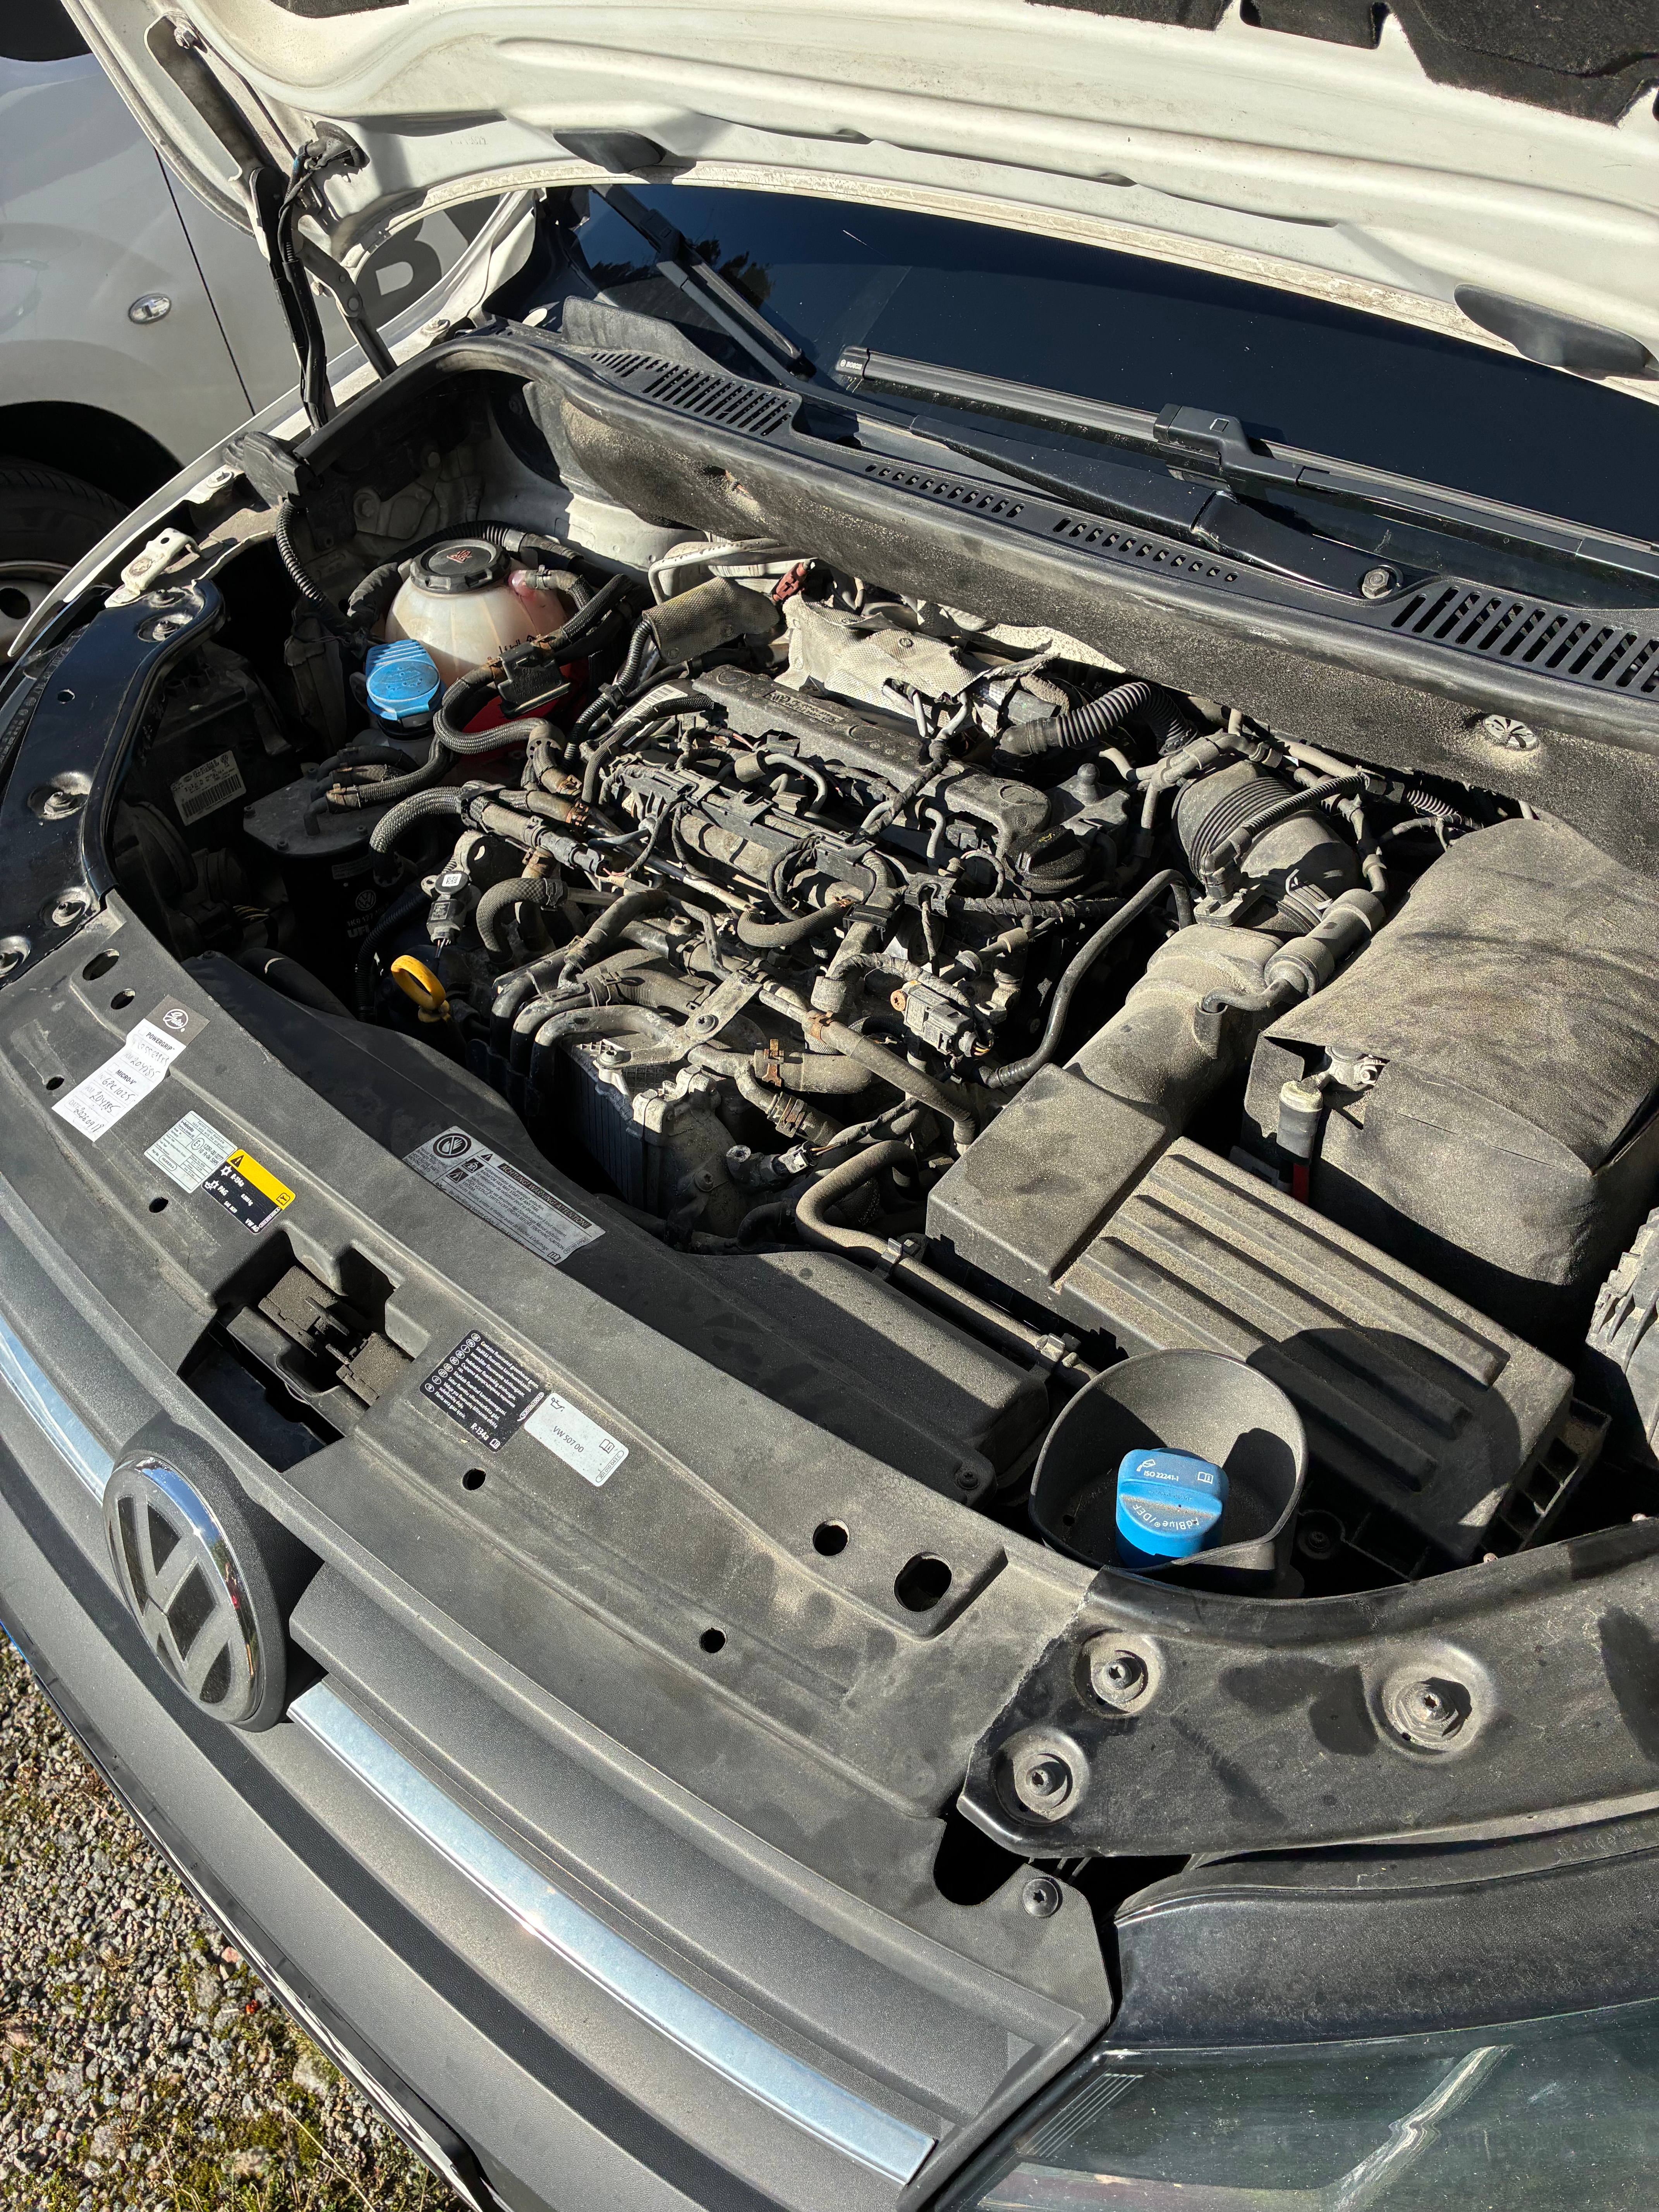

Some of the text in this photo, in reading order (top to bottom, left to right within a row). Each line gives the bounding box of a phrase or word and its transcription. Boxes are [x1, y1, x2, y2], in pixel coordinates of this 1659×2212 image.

[216, 1185, 229, 1196] PAG
[500, 1164, 589, 1227] ACHTUNG! WARNING! ATTENTION!
[508, 1190, 520, 1198] START
[547, 1237, 565, 1250] IGNITION
[479, 1340, 496, 1354] Contains
[493, 1351, 513, 1367] fluorinated
[509, 1364, 531, 1382] greenhouse
[470, 1422, 490, 1441] R-134a
[551, 1425, 585, 1453] VW 507 00
[1156, 1472, 1179, 1482] 22241-1
